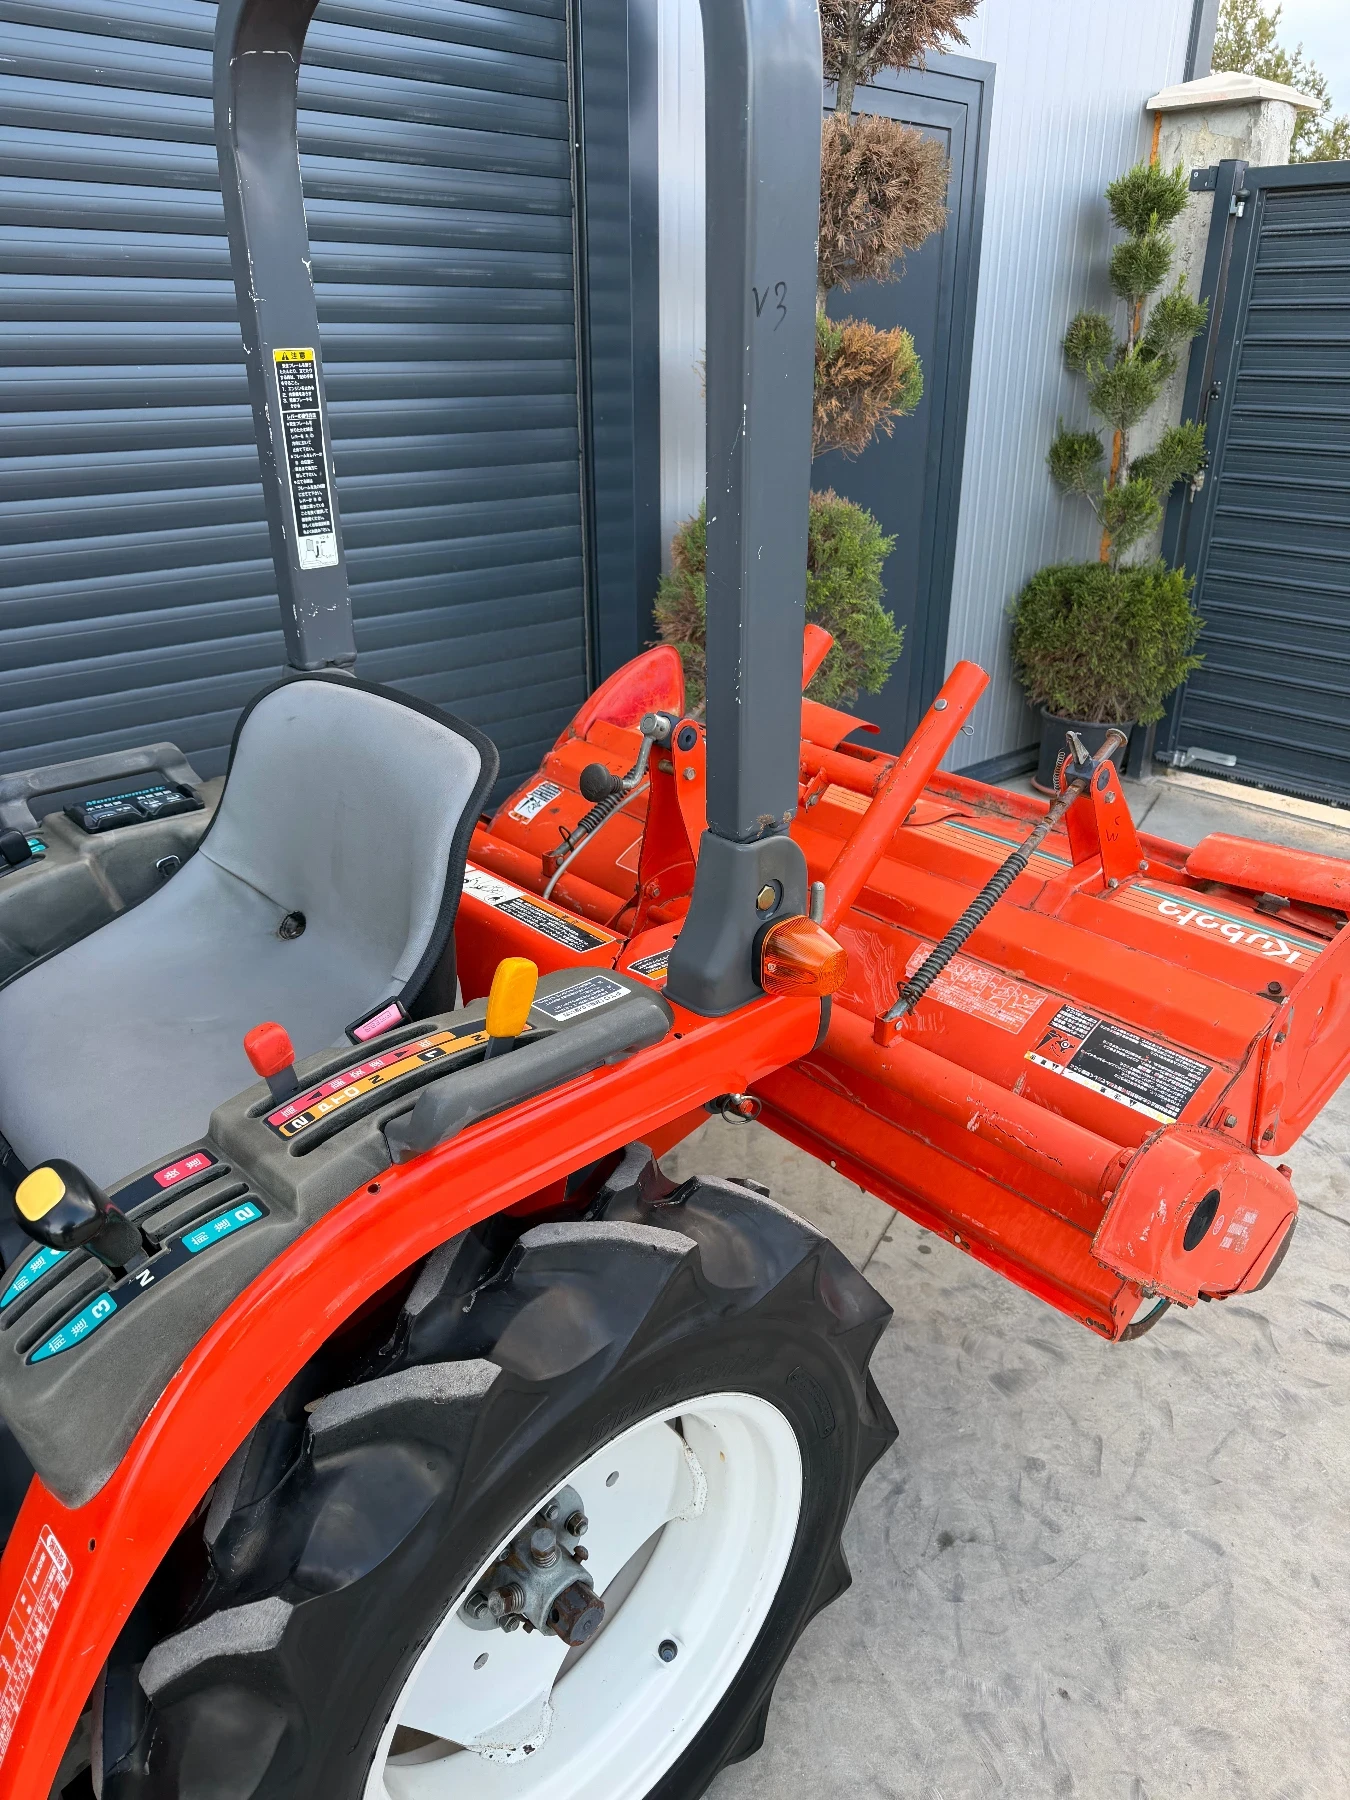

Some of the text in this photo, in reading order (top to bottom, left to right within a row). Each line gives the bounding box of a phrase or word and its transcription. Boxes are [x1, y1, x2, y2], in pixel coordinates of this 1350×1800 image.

[752, 281, 788, 332] V3
[1157, 900, 1302, 964] Kubota
[368, 1074, 384, 1085] N
[317, 1086, 361, 1113] PTO
[291, 1115, 309, 1129] 2
[163, 1157, 203, 1181] 後進
[135, 1268, 155, 1287] N
